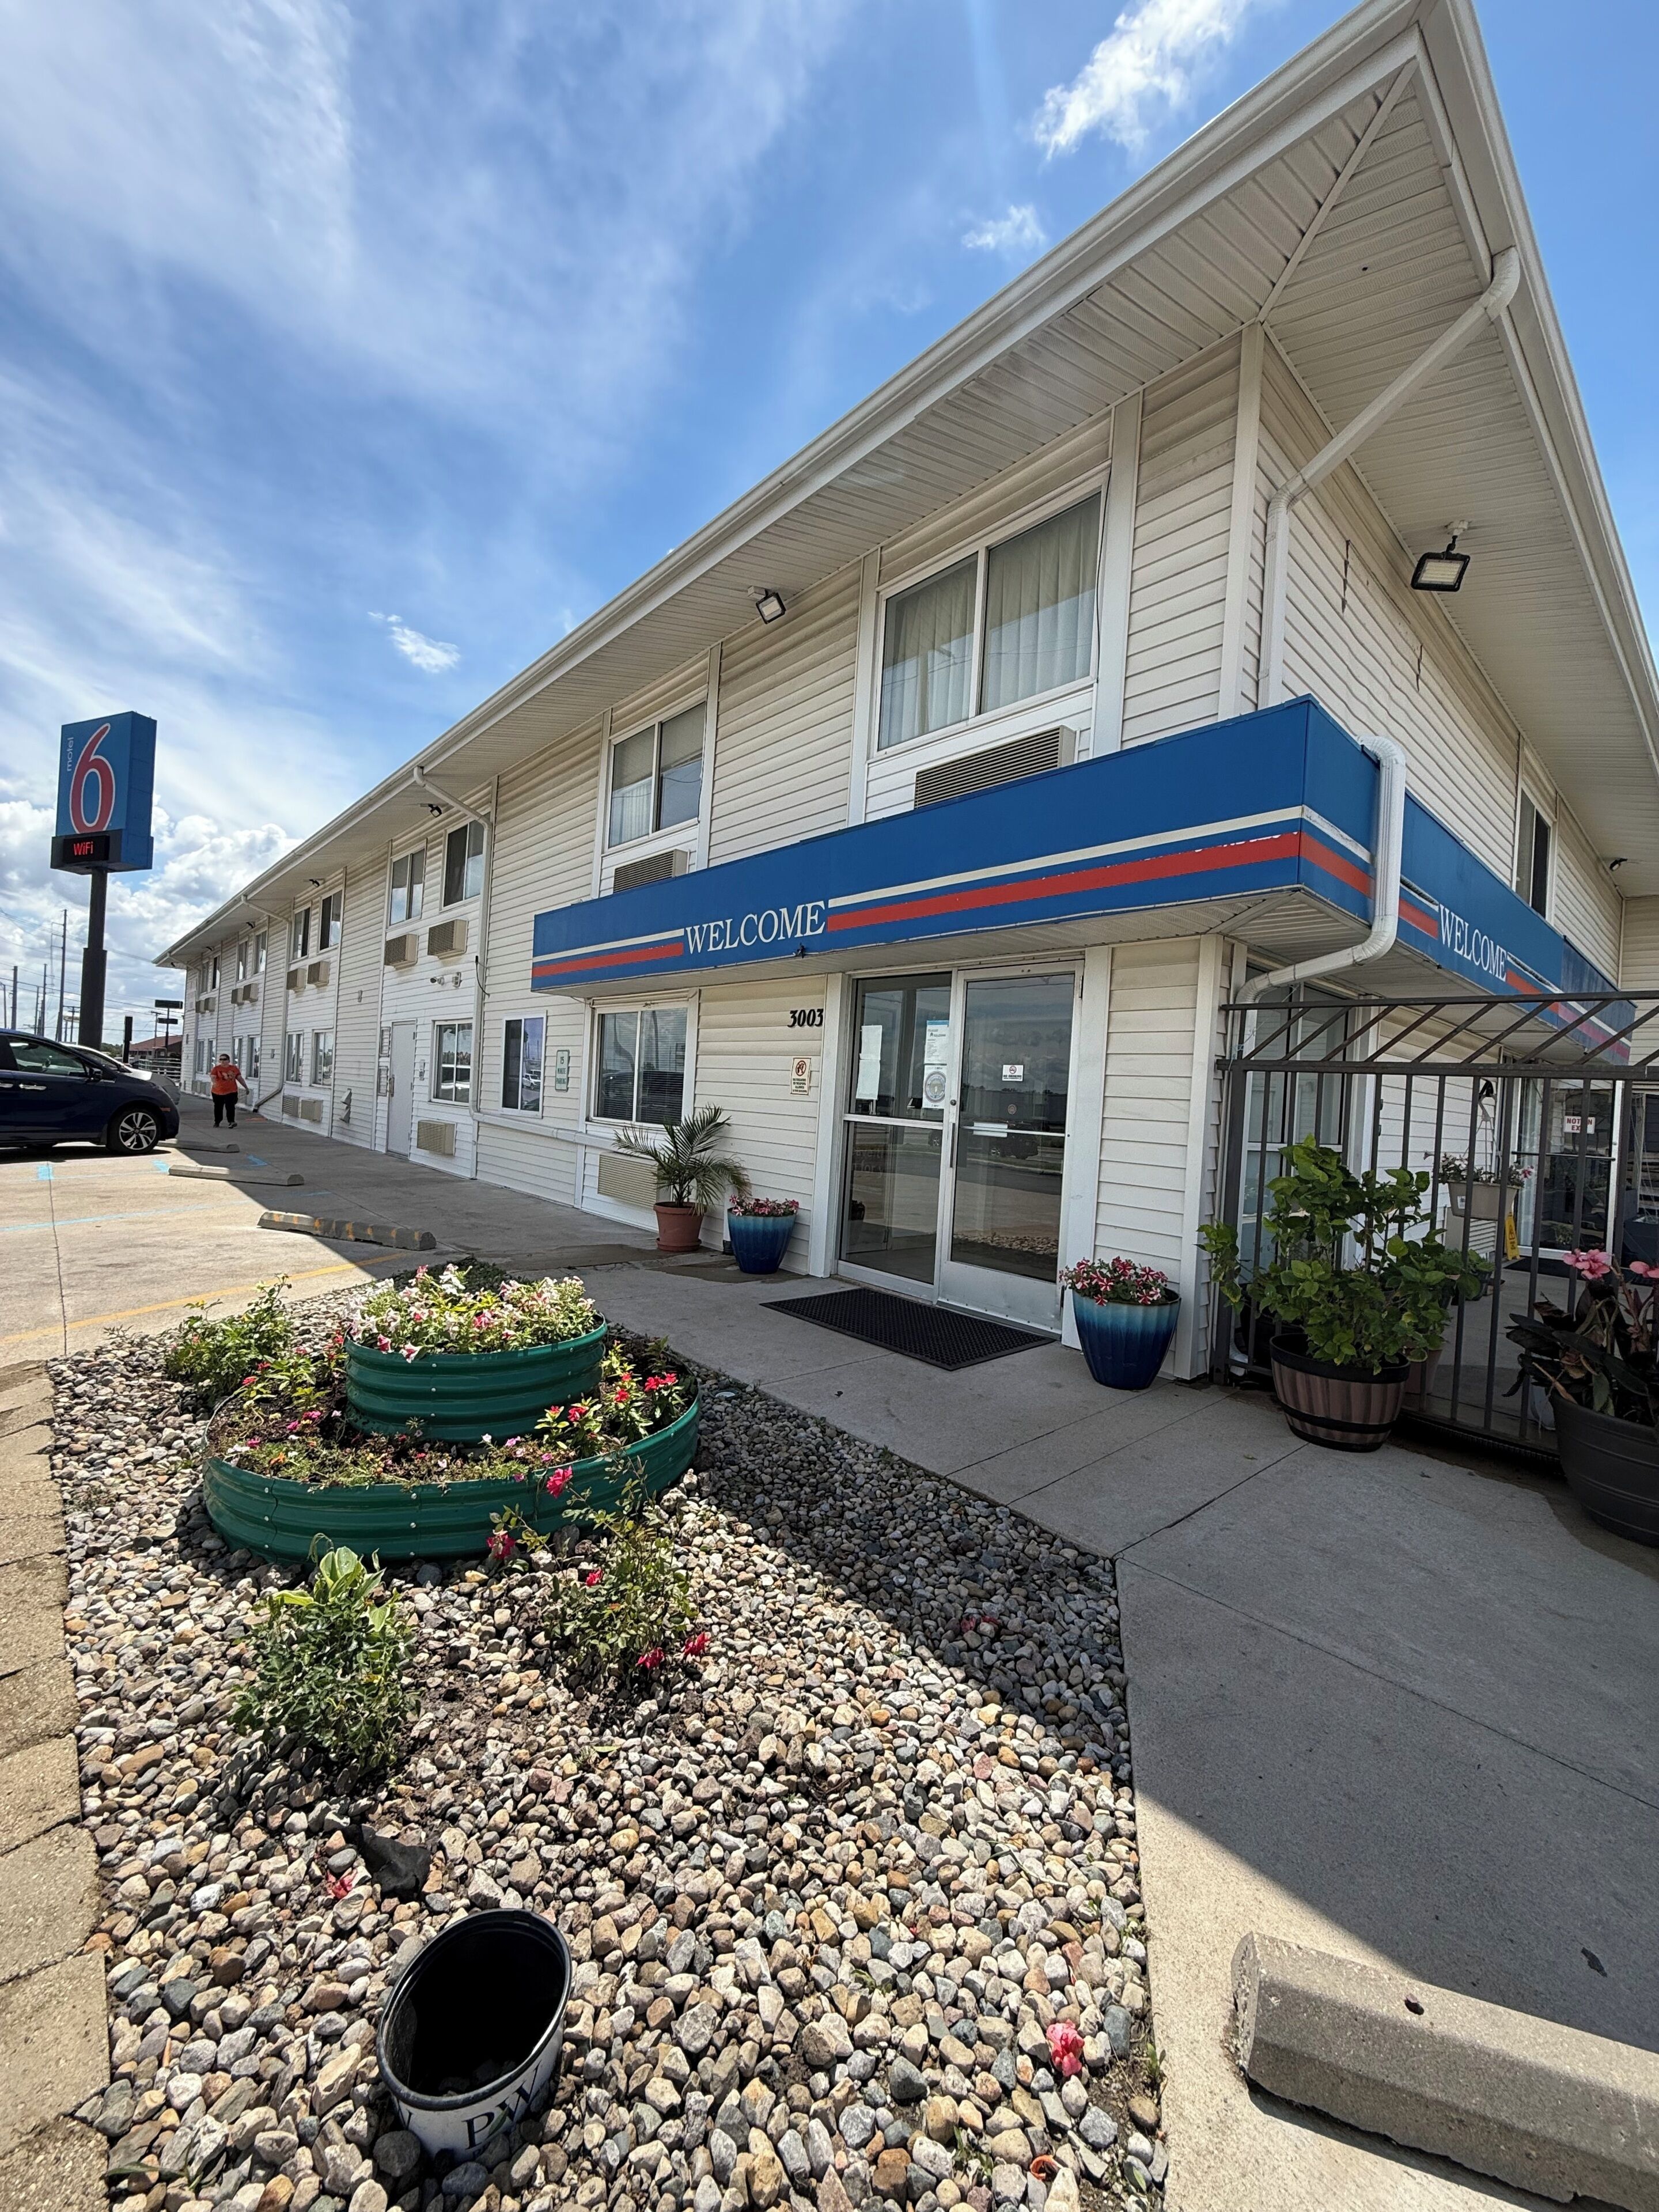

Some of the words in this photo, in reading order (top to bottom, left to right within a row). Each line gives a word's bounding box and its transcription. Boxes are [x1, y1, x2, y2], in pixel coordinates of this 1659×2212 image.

[69, 722, 116, 834] 6
[73, 841, 93, 856] WiFi
[685, 900, 825, 955] WELCOME
[1440, 903, 1508, 982] WELCOME
[787, 1008, 824, 1028] 3003
